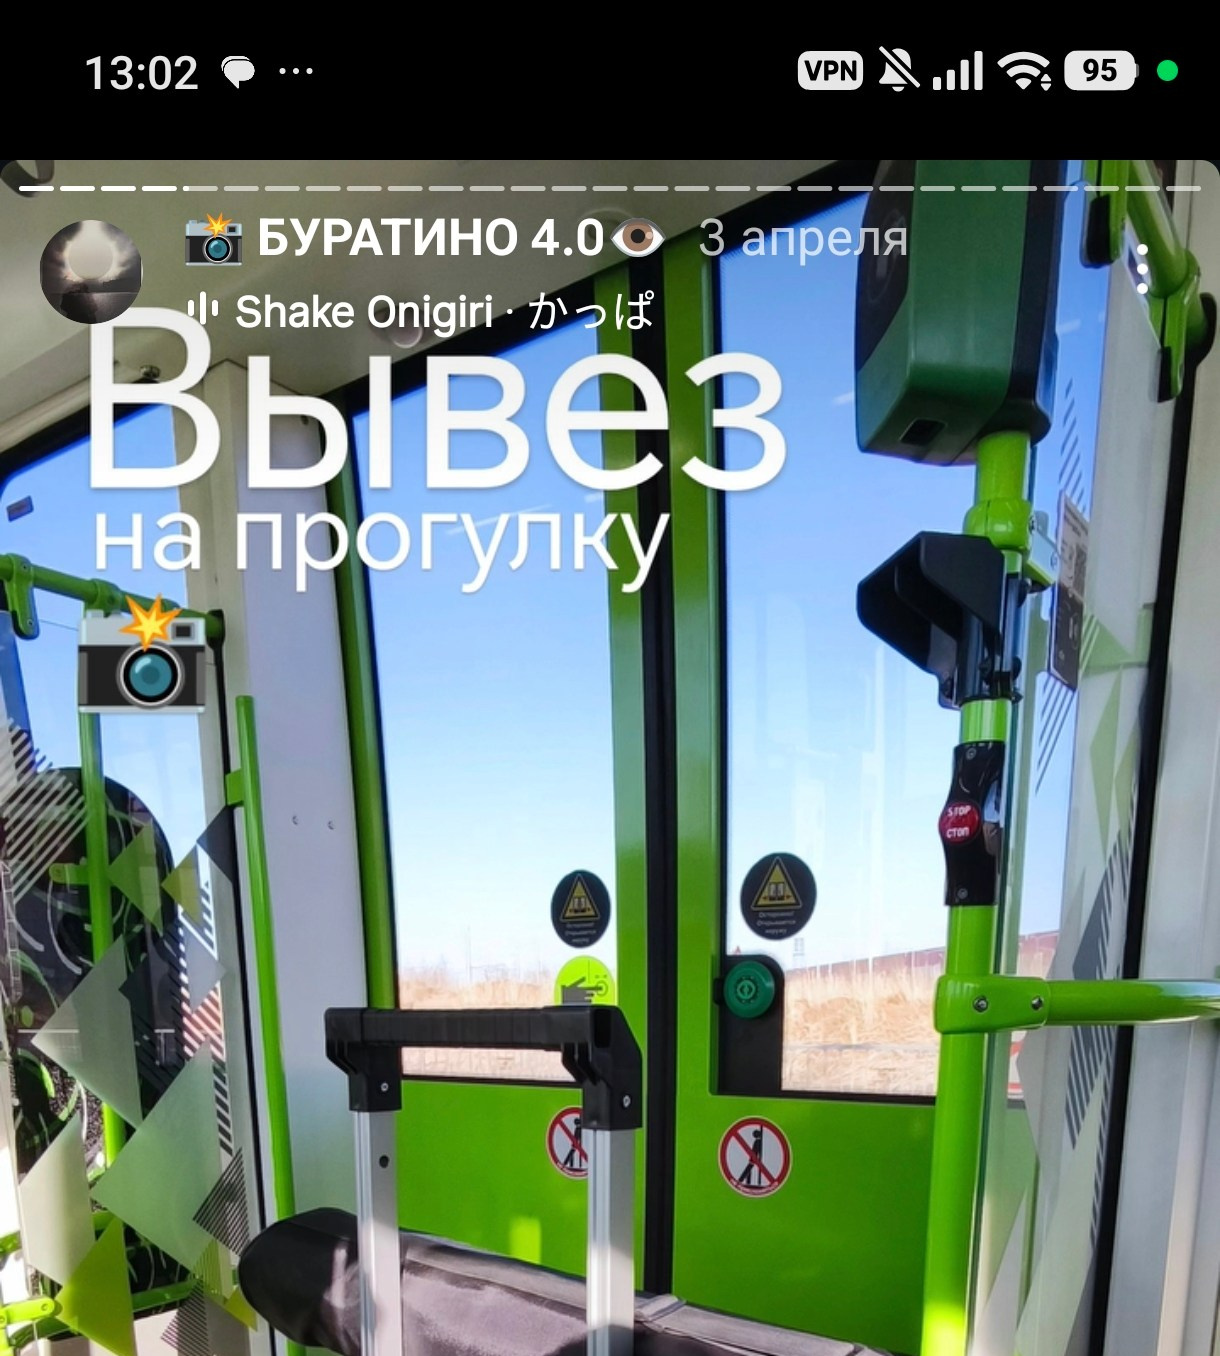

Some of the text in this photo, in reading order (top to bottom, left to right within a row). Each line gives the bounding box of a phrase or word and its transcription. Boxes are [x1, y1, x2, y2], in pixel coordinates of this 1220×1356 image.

[86, 55, 199, 91] 13:02
[804, 60, 858, 82] VPN
[1082, 58, 1117, 82] 95
[947, 804, 972, 817] STOP
[946, 826, 970, 839] СТОП
